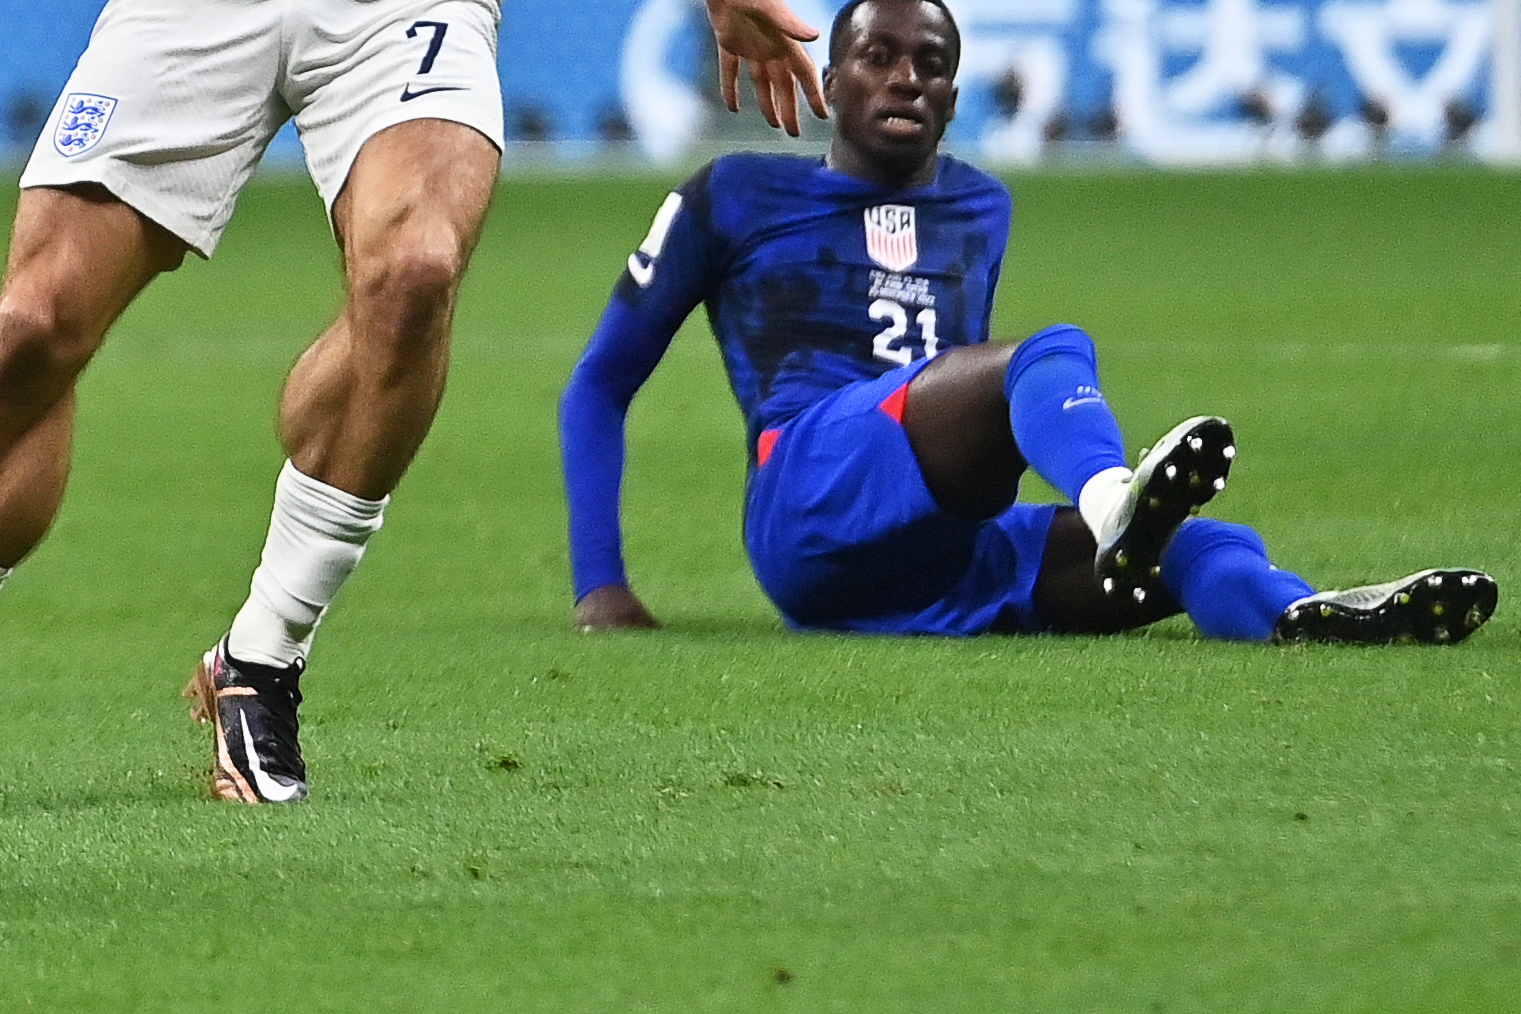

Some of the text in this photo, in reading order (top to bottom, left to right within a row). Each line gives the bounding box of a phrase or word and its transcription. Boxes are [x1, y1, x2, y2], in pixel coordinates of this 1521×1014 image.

[405, 20, 449, 75] 7
[868, 207, 911, 234] USA
[868, 298, 940, 368] 21
